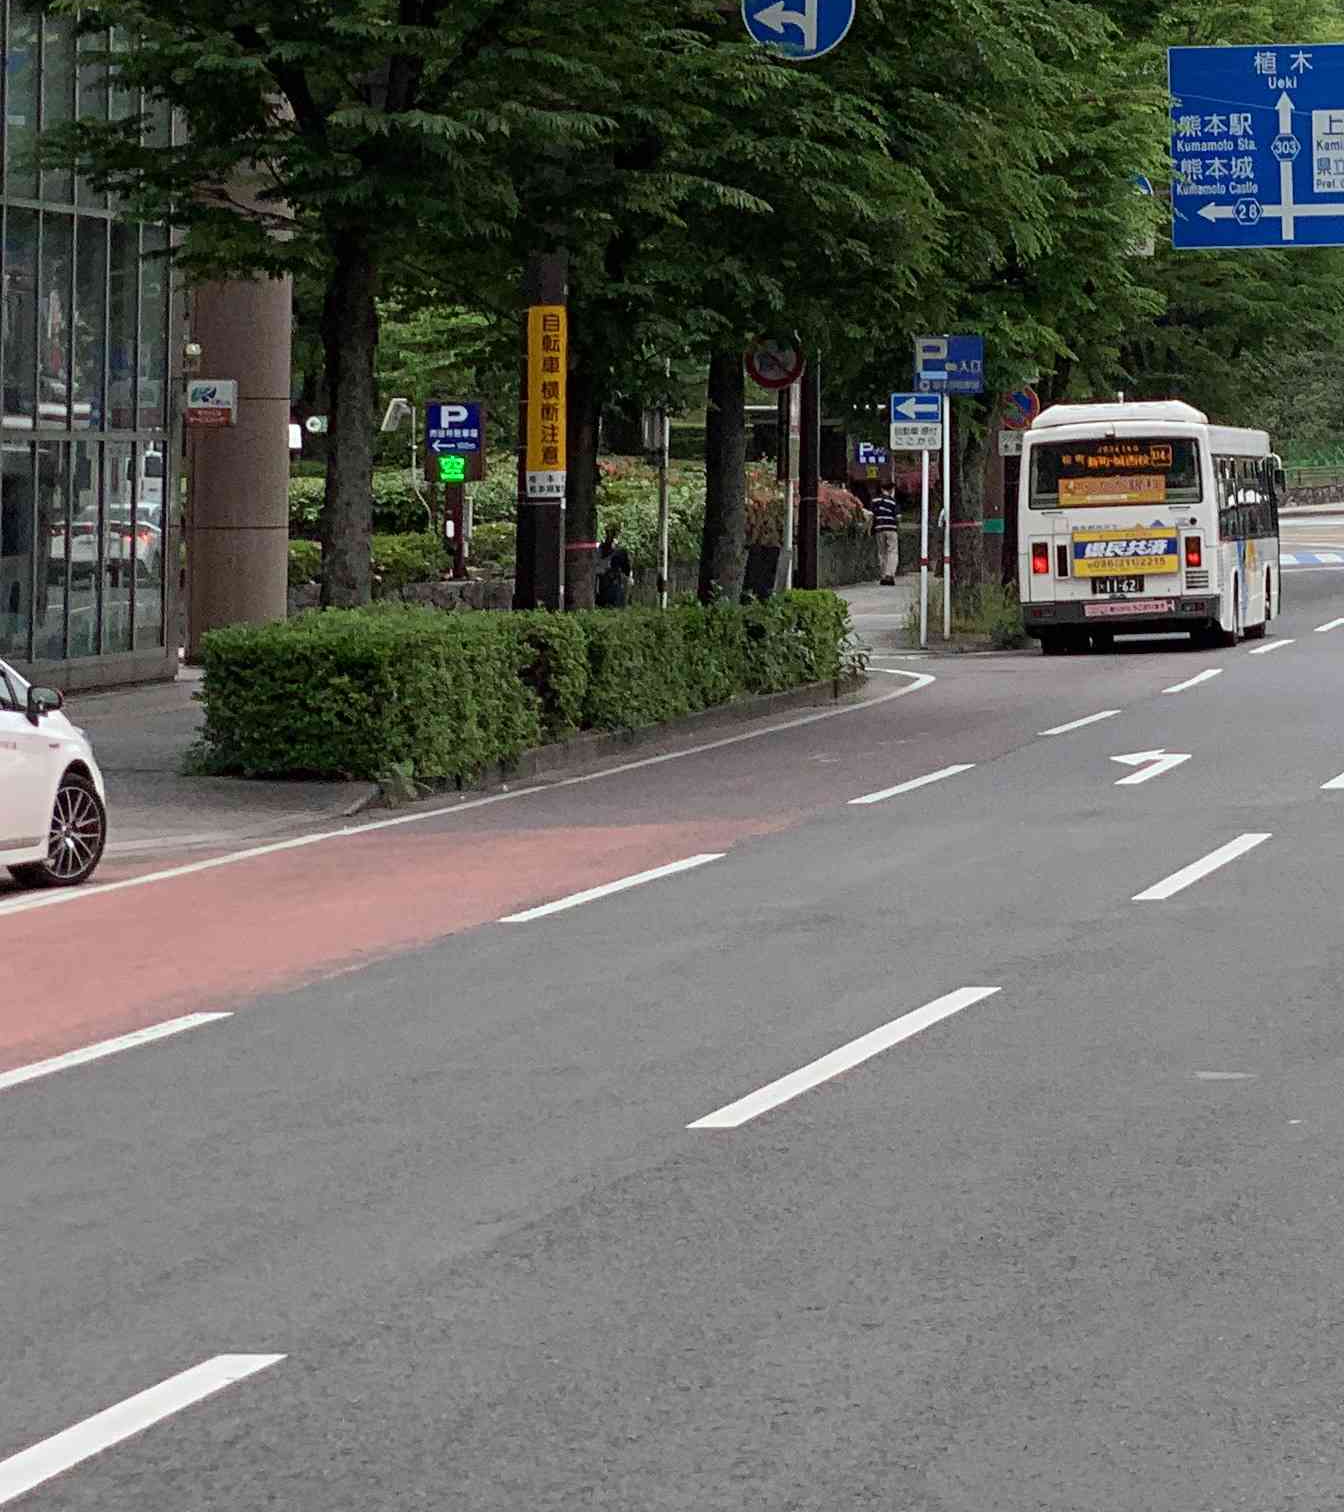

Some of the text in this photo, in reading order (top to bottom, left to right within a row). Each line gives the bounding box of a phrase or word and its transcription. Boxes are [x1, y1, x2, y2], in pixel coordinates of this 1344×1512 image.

[1254, 49, 1313, 74] 植木
[1268, 75, 1297, 89] Ueki
[1179, 113, 1254, 137] 熊本駅
[1176, 139, 1234, 153] Kumamoto
[1274, 141, 1298, 155] 303
[1181, 155, 1255, 183] 熊本城
[1176, 183, 1227, 196] Kumamoto
[1239, 204, 1258, 219] 28
[541, 313, 561, 466] 自転車横断注意
[441, 405, 469, 428] P
